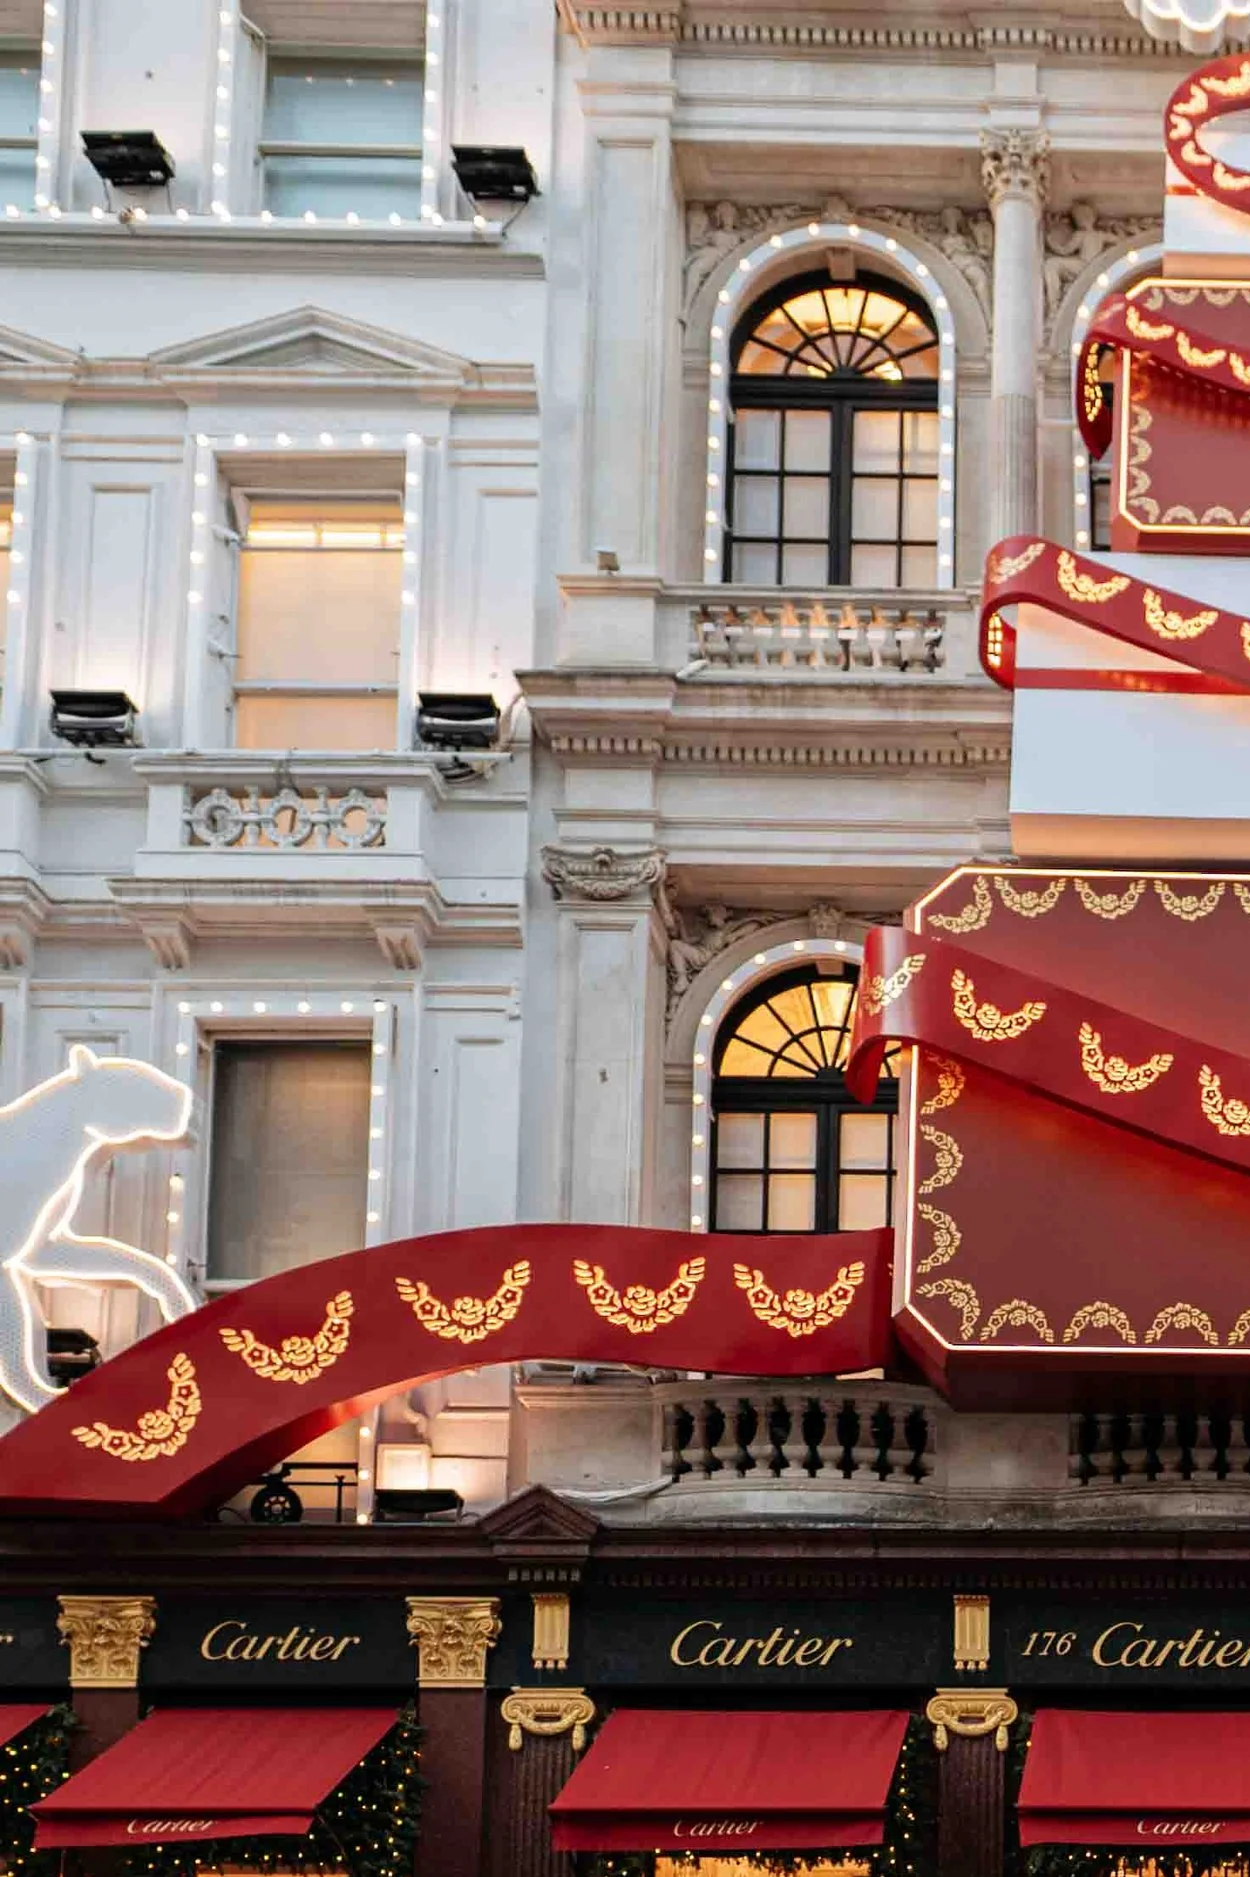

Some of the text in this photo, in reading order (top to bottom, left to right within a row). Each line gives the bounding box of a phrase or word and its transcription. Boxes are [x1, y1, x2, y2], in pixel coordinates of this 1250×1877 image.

[201, 1619, 361, 1661] Cartier
[670, 1620, 853, 1667] Cartier
[1021, 1631, 1077, 1656] 176
